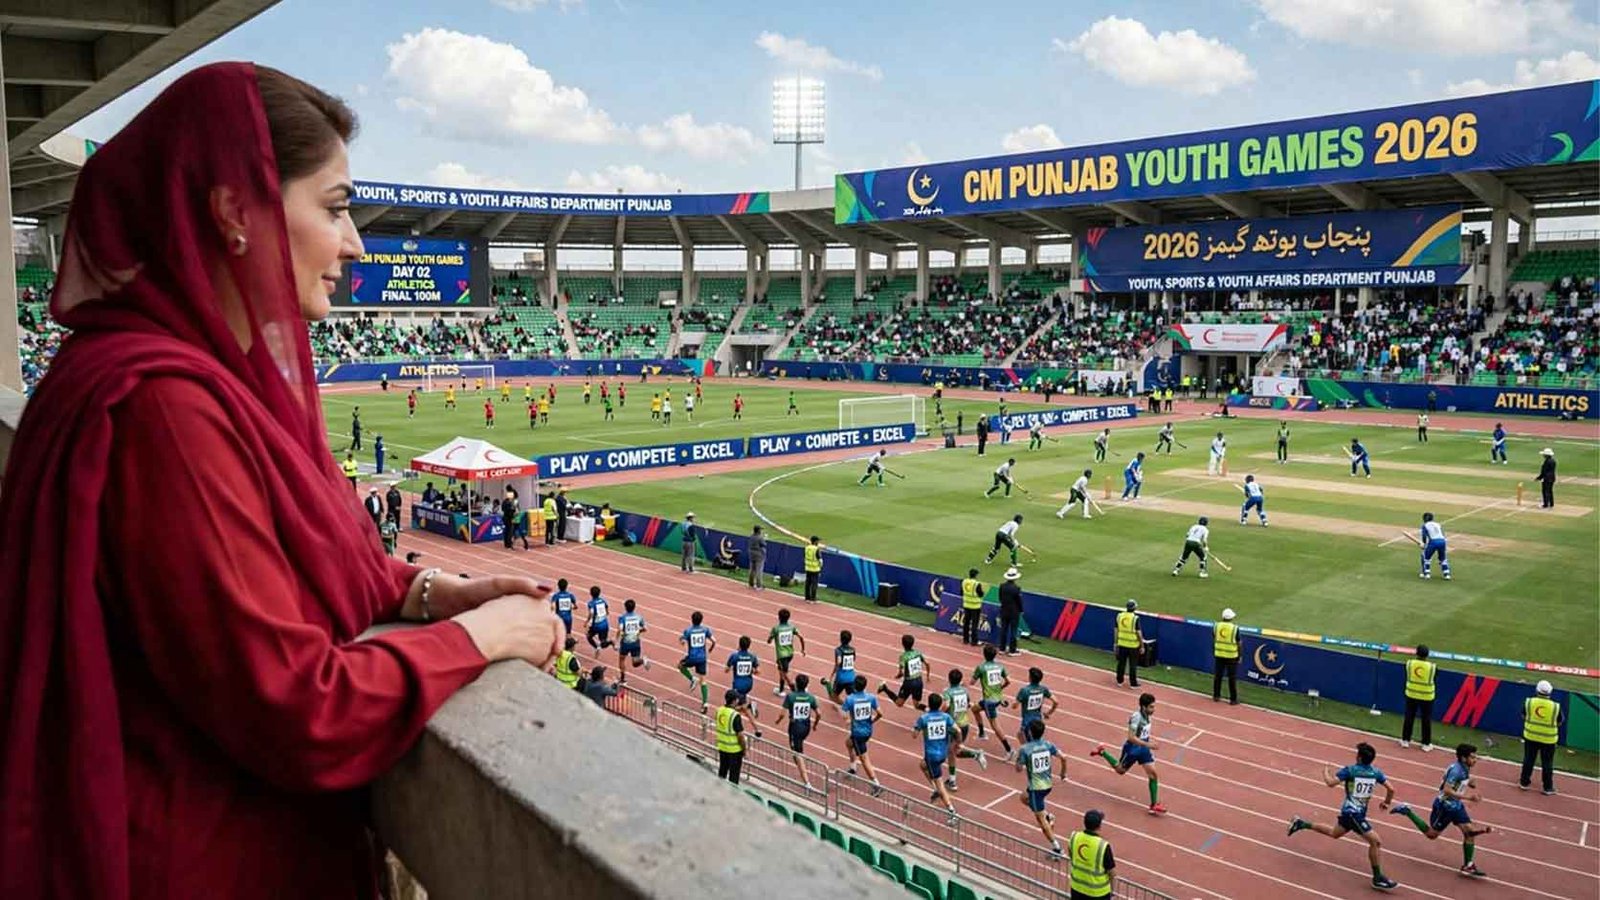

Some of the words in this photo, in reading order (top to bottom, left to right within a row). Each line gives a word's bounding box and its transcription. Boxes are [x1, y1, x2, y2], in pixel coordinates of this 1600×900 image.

[964, 168, 1002, 203] CM
[1009, 155, 1119, 198] PUNJAB
[1125, 141, 1229, 187] YOUTH
[1239, 126, 1364, 177] GAMES
[1374, 113, 1478, 164] 2026
[354, 186, 398, 204] YOUTH,
[400, 189, 446, 204] SPORTS
[449, 192, 458, 205] &
[460, 193, 499, 207] YOUTH
[501, 195, 549, 209] AFFAIRS
[551, 197, 625, 211] DEPARTMENT
[628, 200, 672, 211] PUNJAB
[1143, 232, 1199, 260] 2026
[1203, 223, 1250, 261] گیمز
[1303, 222, 1372, 257] پنجاب
[374, 253, 406, 264] PUNJAB
[408, 254, 435, 264] YOUTH
[436, 255, 464, 266] GAMES
[392, 265, 416, 278] DAY
[416, 265, 431, 278] 02
[1128, 277, 1164, 291] YOUTH,
[1165, 276, 1206, 289] SPORTS
[1207, 275, 1215, 288] &
[1217, 275, 1253, 288] YOUTH
[1255, 273, 1300, 287] AFFAIRS
[1303, 271, 1381, 286] DEPARTMENT
[1384, 270, 1436, 284] PUNJAB
[387, 279, 436, 290] ATHLETICS
[382, 291, 412, 301] FINAL
[414, 291, 441, 301] 100M
[399, 364, 460, 376] ATHLETICS
[1494, 392, 1589, 412] ATHLETICS
[1061, 407, 1099, 422] COMPETE
[760, 437, 790, 454] PLAY
[805, 431, 860, 448] COMPETE
[872, 427, 906, 443] EXCEL
[550, 455, 590, 474] PLAY
[607, 447, 676, 468] COMPETE
[692, 442, 735, 460] EXCEL
[929, 725, 945, 736] 145
